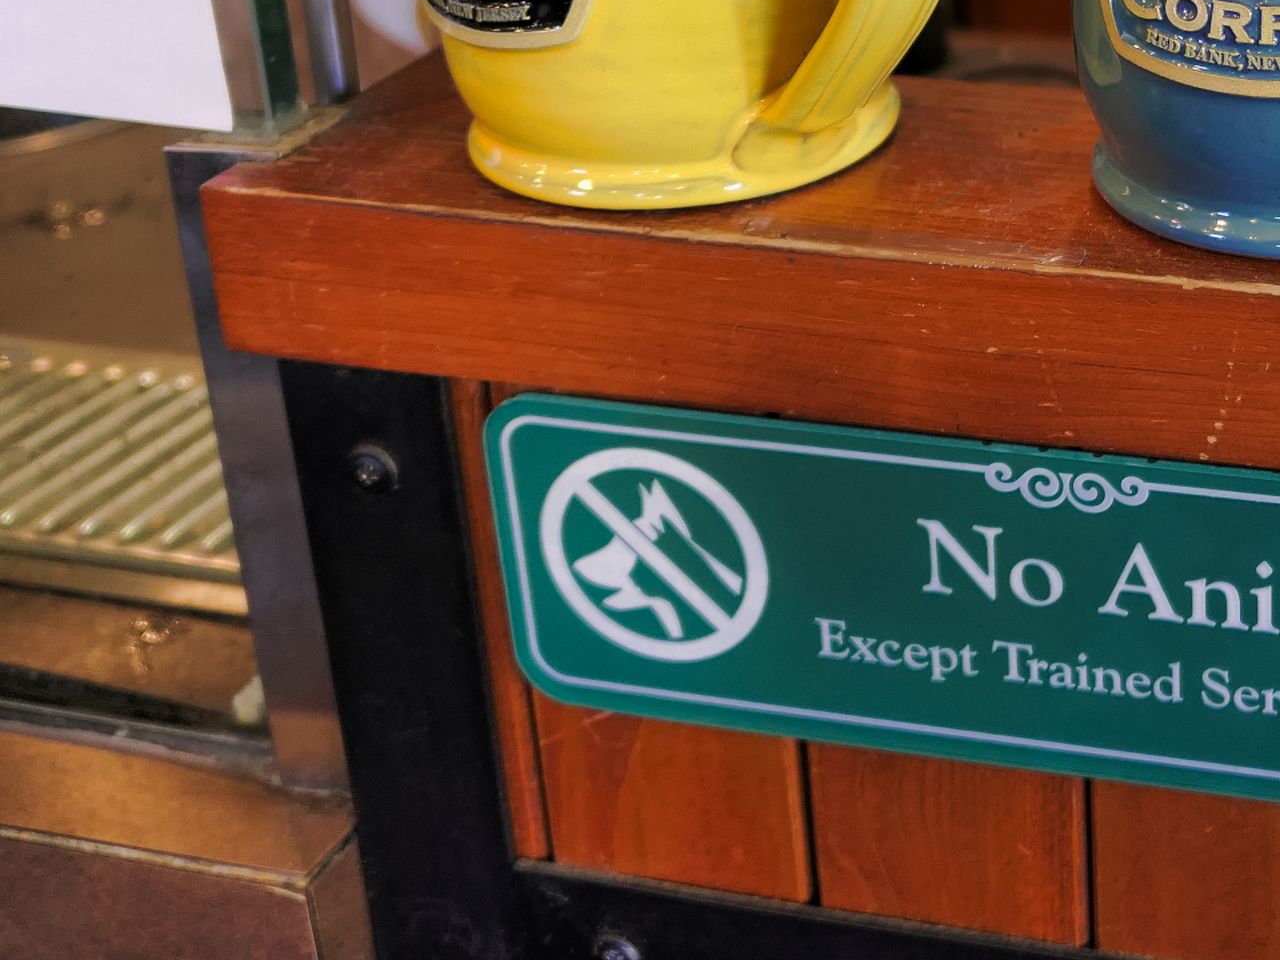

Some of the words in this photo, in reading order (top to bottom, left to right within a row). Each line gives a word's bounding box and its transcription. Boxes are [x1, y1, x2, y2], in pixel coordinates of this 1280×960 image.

[1145, 27, 1182, 58] RED
[915, 517, 1065, 608] No
[813, 616, 979, 683] Except
[991, 639, 1184, 705] Trained
